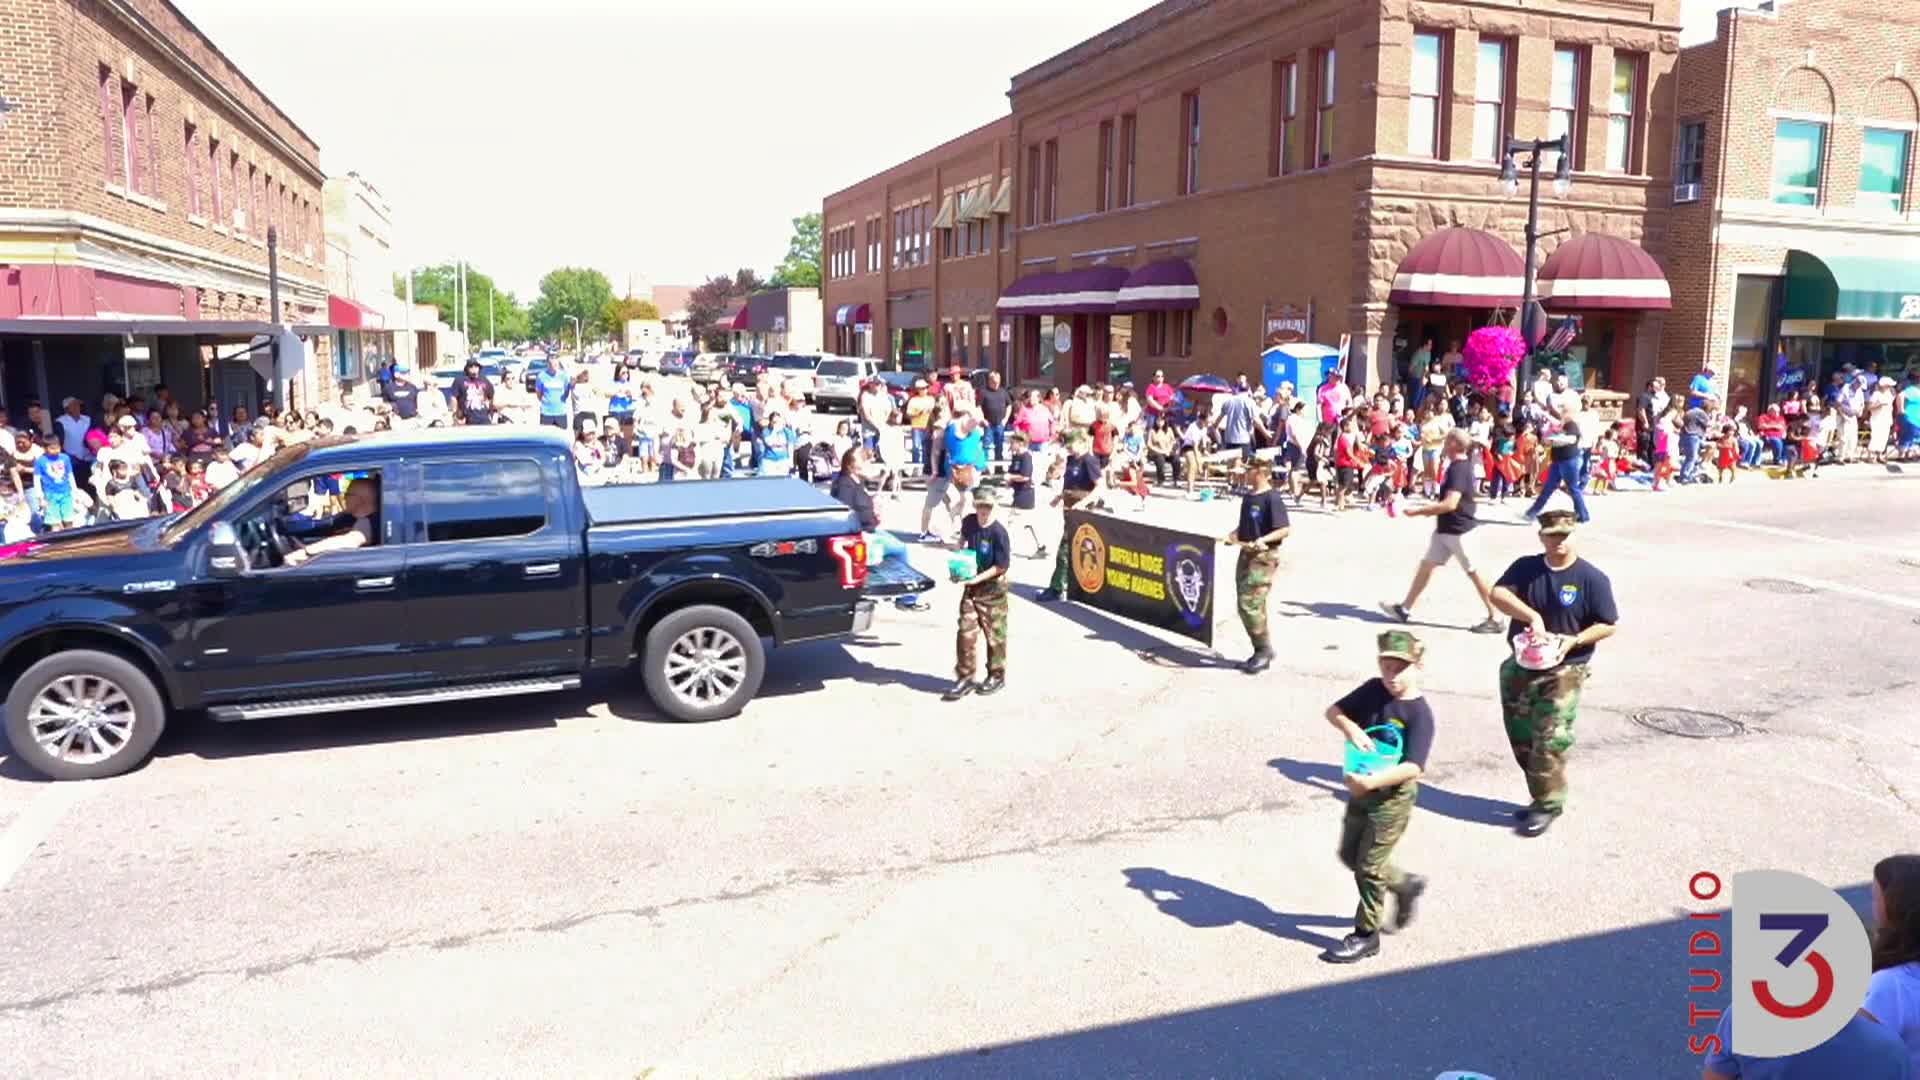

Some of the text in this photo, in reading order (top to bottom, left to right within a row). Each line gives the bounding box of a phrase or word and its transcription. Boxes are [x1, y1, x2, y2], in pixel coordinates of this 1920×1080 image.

[1109, 545, 1163, 575] BUFFALO RIDGE
[1106, 568, 1165, 600] YOUNG MARINES
